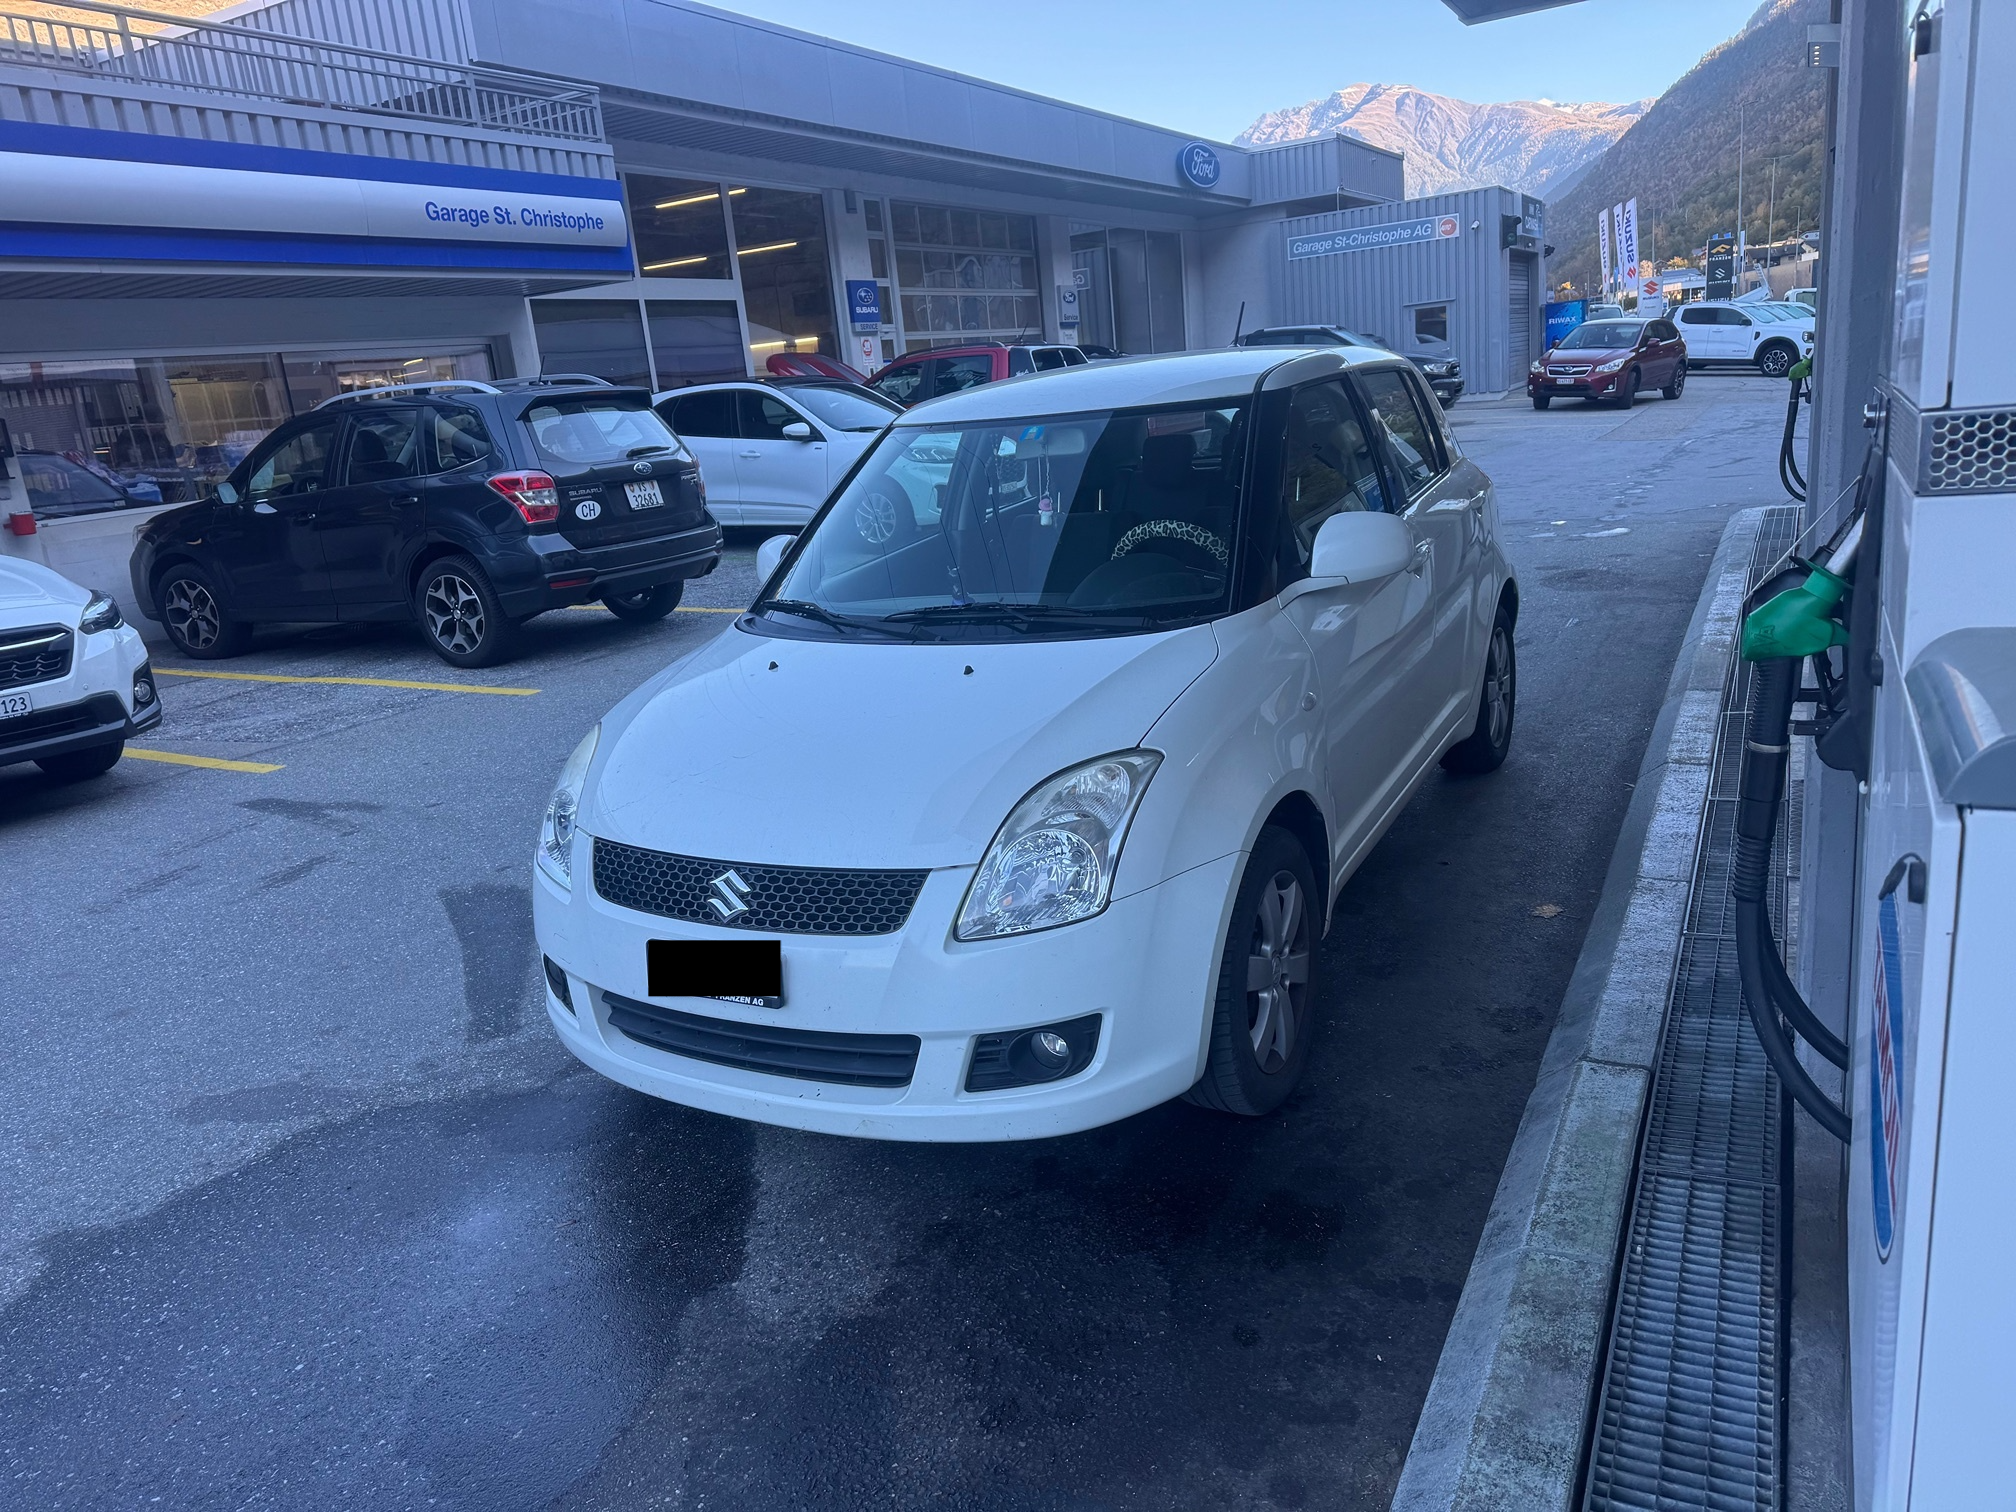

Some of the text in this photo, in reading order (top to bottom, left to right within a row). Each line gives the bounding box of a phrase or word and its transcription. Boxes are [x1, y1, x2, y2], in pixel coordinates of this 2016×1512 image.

[1191, 148, 1215, 178] Ford
[424, 201, 604, 233] Garage St. Christophe
[1293, 239, 1332, 254] Garage
[1334, 228, 1411, 248] St-Christophe
[1412, 223, 1432, 237] AG
[855, 306, 879, 314] SUBARU
[1548, 316, 1577, 325] RIWAX
[568, 487, 603, 496] SUBARU
[636, 481, 647, 492] VS
[632, 492, 660, 508] 32681
[581, 503, 596, 518] CH
[0, 697, 27, 714] 123
[752, 997, 764, 1006] AG
[1873, 926, 1900, 1217] TAMOIL
